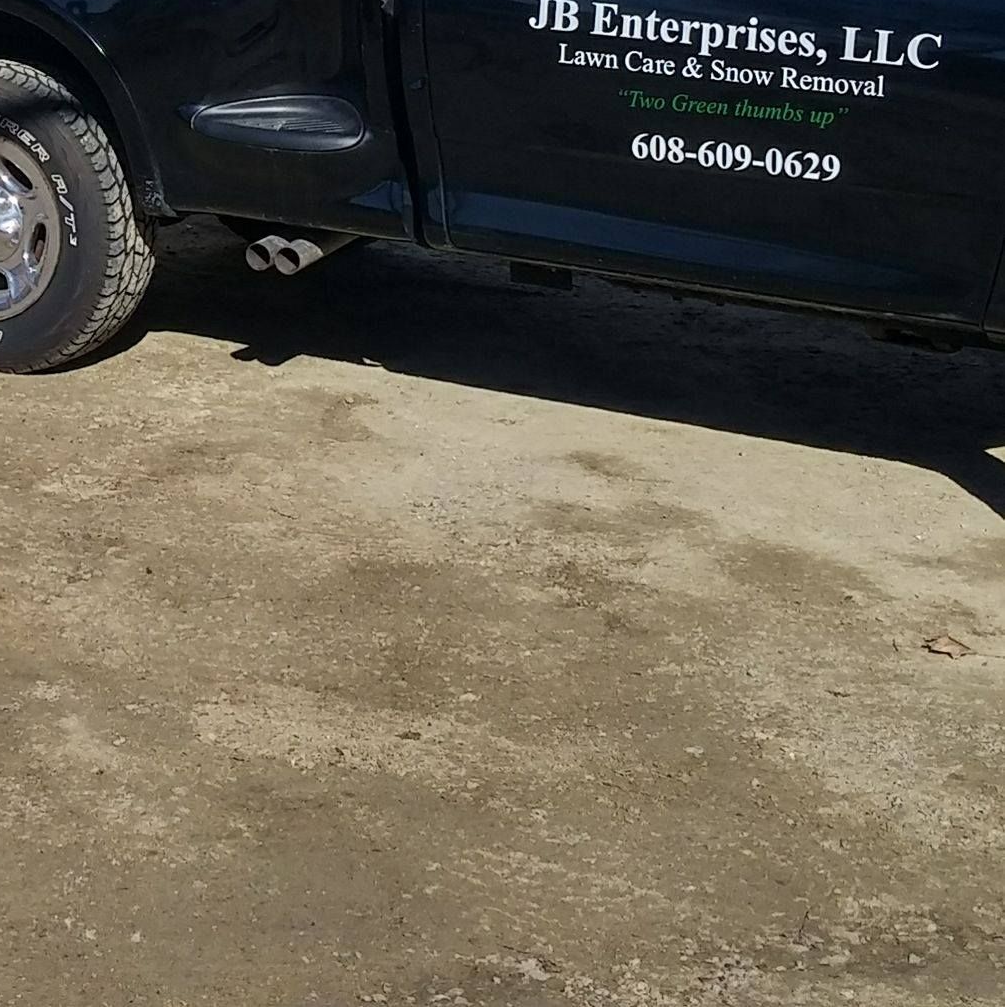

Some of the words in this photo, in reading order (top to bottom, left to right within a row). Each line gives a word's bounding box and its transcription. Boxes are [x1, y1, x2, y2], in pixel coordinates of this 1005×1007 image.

[589, 1, 827, 65] Enterprises,
[839, 26, 943, 70] LLC
[558, 43, 619, 70] Lawn
[624, 51, 676, 76] Care
[681, 56, 703, 79] &
[710, 59, 775, 86] Snow
[780, 67, 885, 98] Removal
[671, 93, 729, 116] Green
[734, 98, 804, 123] thumbs
[631, 132, 841, 182] 608-609-0629
